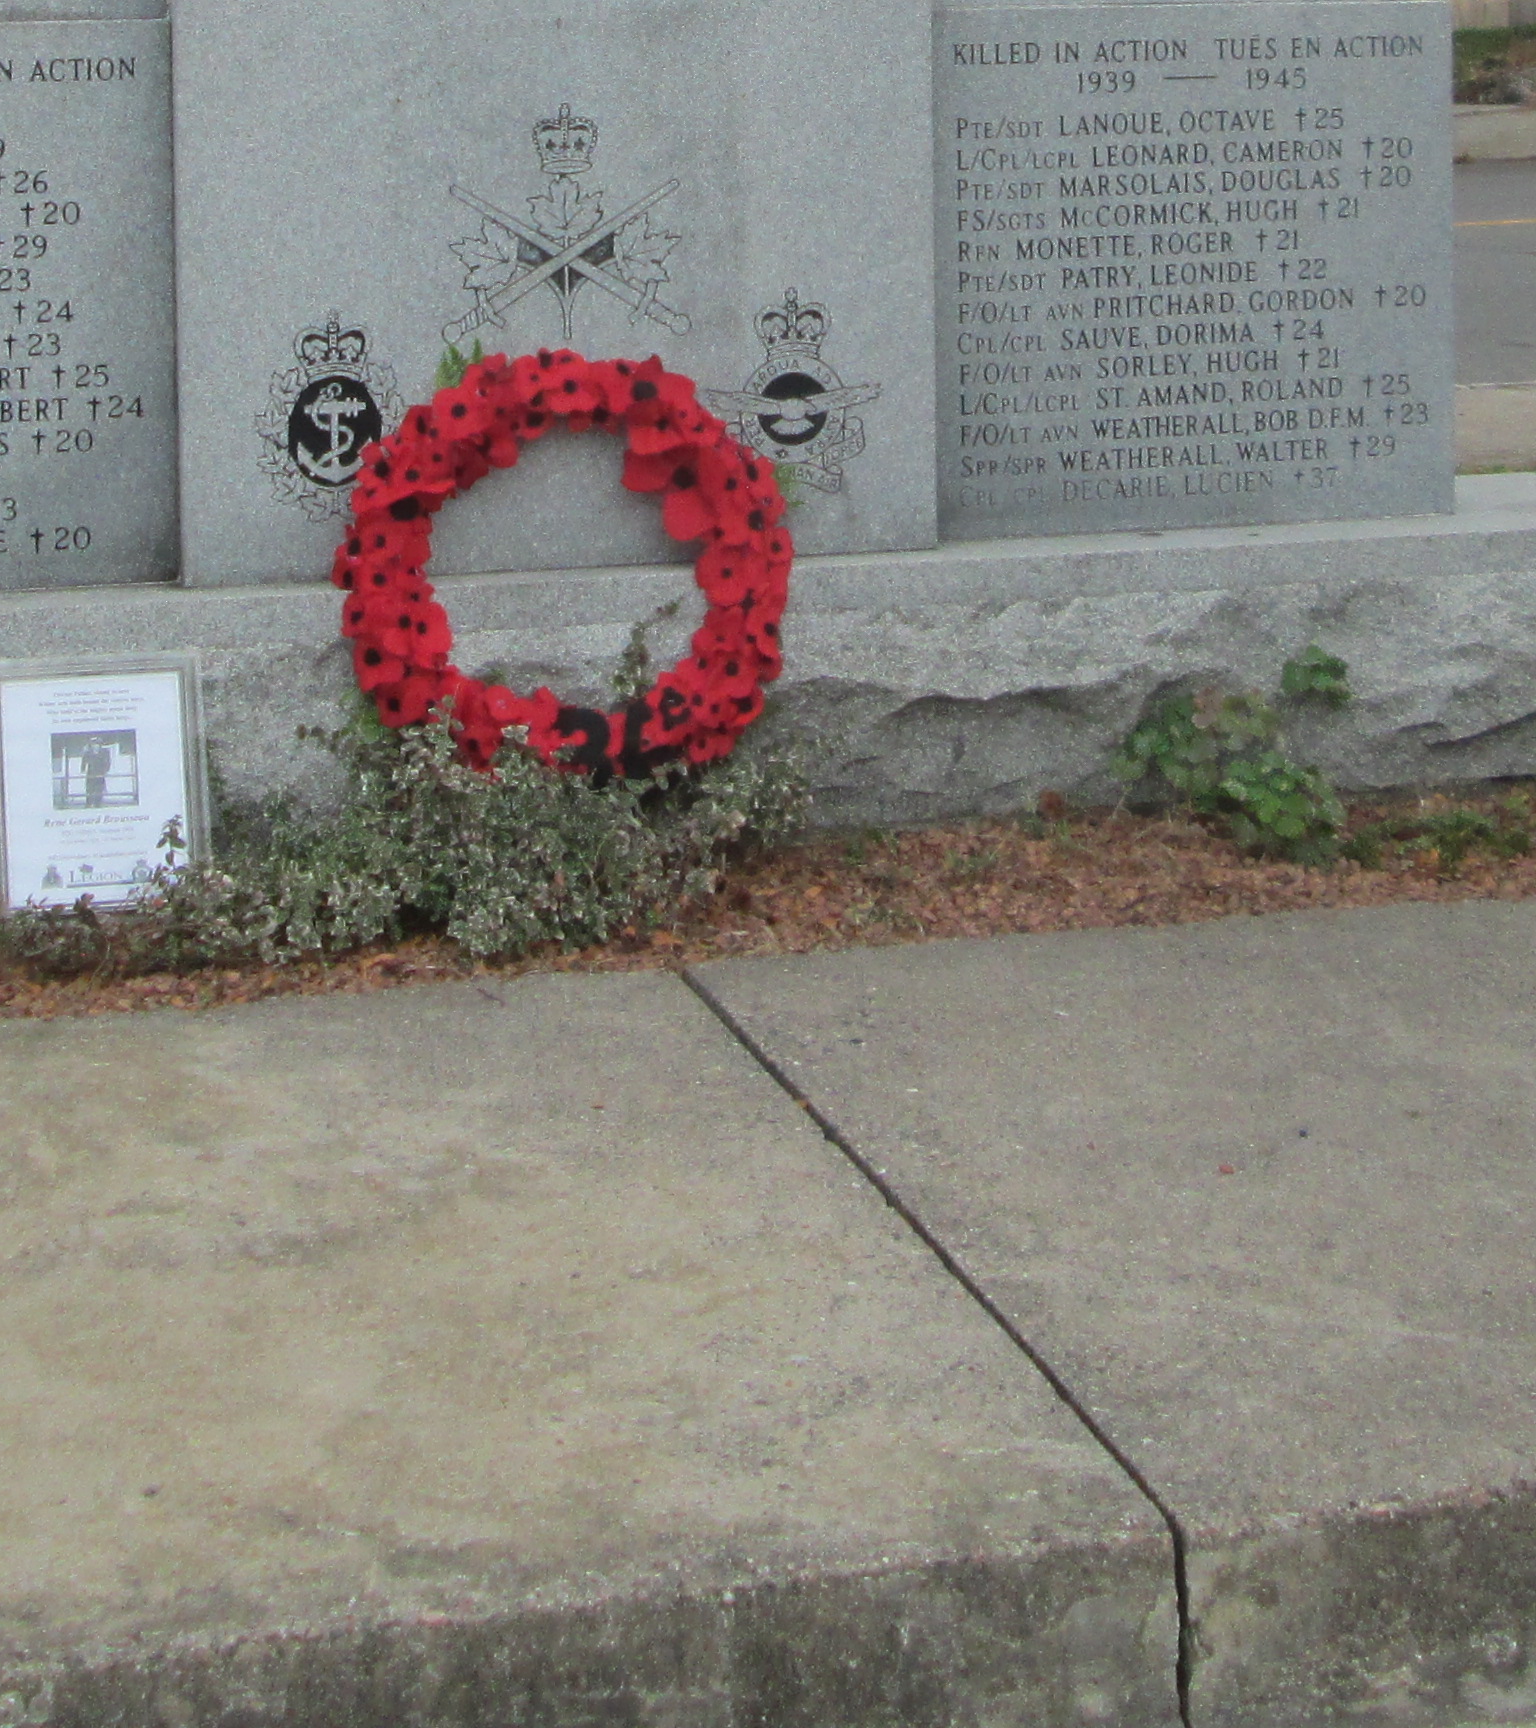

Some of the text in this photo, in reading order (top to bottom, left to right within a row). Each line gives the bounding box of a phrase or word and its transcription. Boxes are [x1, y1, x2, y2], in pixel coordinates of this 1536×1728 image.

[953, 35, 1424, 66] KILLED IN ACTION TUÉS EN ACTION
[30, 58, 138, 82] ACTION
[1077, 68, 1306, 94] 1939 1945
[1058, 109, 1274, 137] LANOUE, OCTAVE
[1092, 140, 1343, 166] LEONARD, CAMERON
[1059, 169, 1340, 197] MARSOLAIS, DOUGLAS
[1016, 232, 1233, 260] MONETTE, ROGER
[1062, 262, 1258, 290] PATRY, LEONIDE
